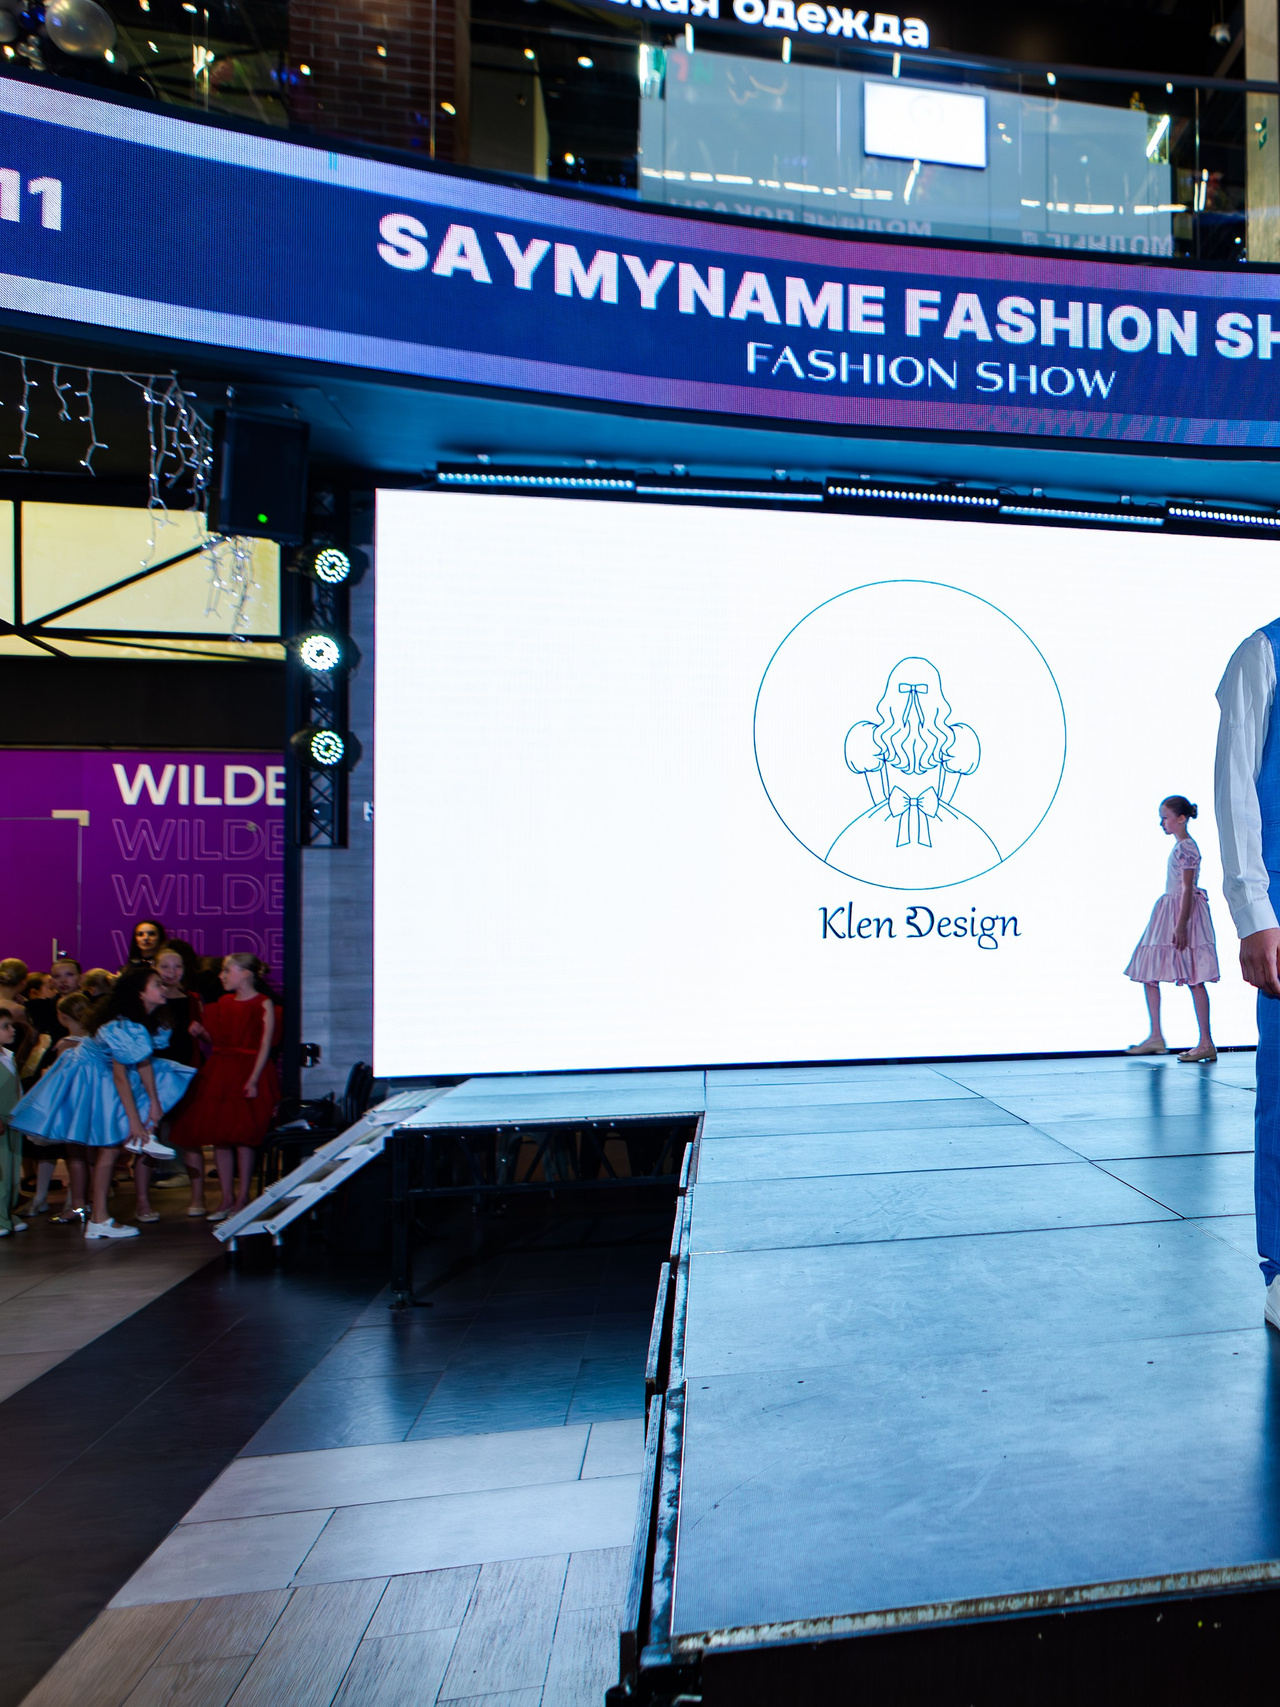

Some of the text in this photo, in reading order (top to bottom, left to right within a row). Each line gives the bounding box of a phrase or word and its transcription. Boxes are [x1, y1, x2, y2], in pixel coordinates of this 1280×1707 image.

[732, 0, 930, 48] одежда
[378, 213, 886, 335] SAYMYNAME
[905, 288, 1198, 356] FASHION
[745, 341, 1117, 399] FASHION SHOW
[817, 901, 1023, 951] Klen Design
